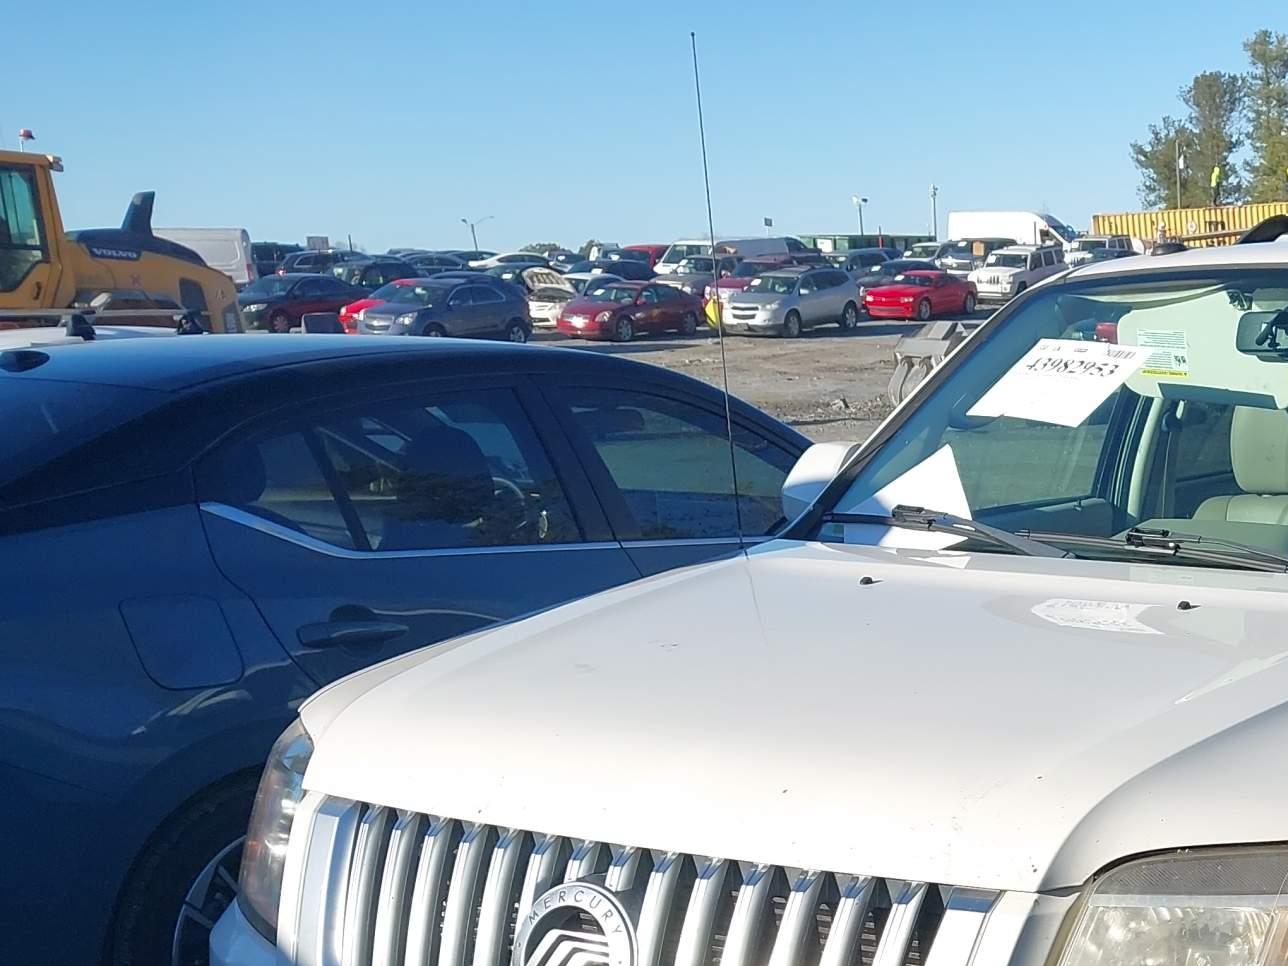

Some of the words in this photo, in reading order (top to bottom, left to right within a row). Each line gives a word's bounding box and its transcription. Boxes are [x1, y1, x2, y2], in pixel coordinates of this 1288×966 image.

[92, 247, 137, 260] VOLVO
[1025, 357, 1120, 377] 43982953
[528, 889, 623, 933] MERCURY
